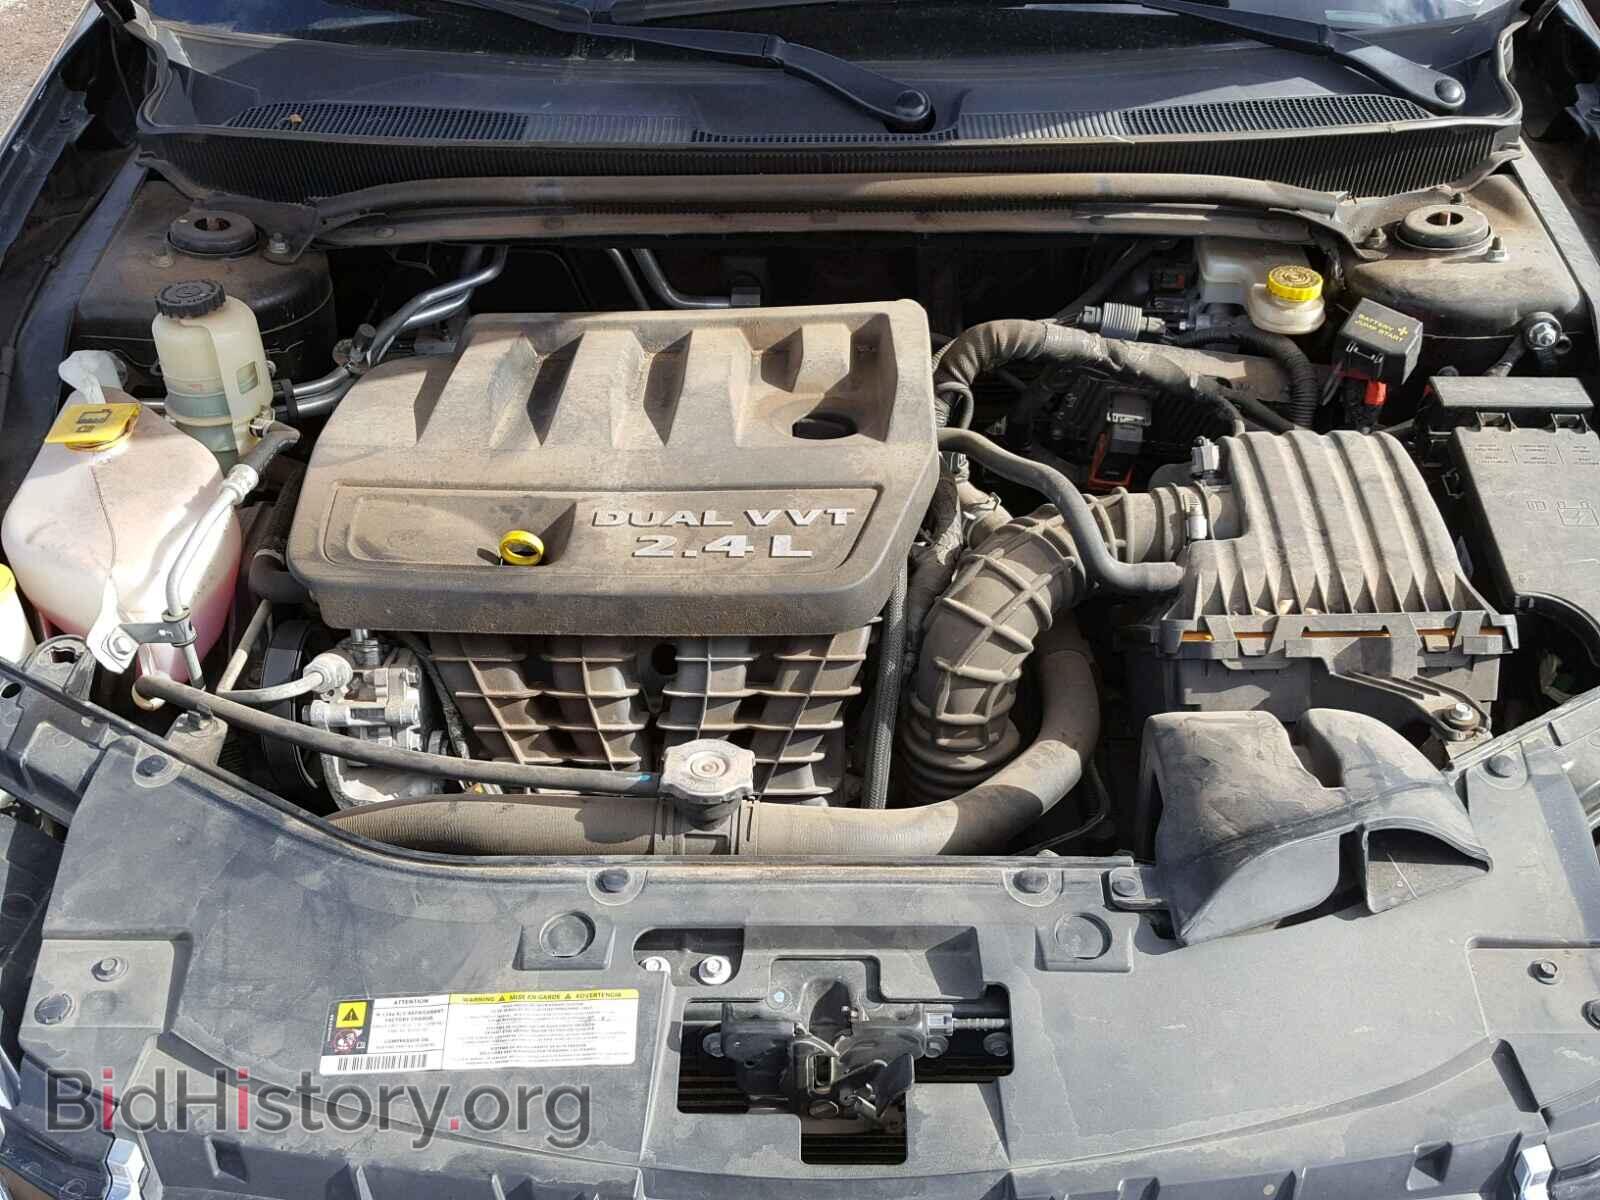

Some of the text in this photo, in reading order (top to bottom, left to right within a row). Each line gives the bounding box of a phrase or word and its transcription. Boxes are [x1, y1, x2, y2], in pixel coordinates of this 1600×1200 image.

[1354, 319, 1404, 343] JUMP START
[1358, 313, 1394, 332] BATTERY
[591, 508, 856, 527] DUAL VVT
